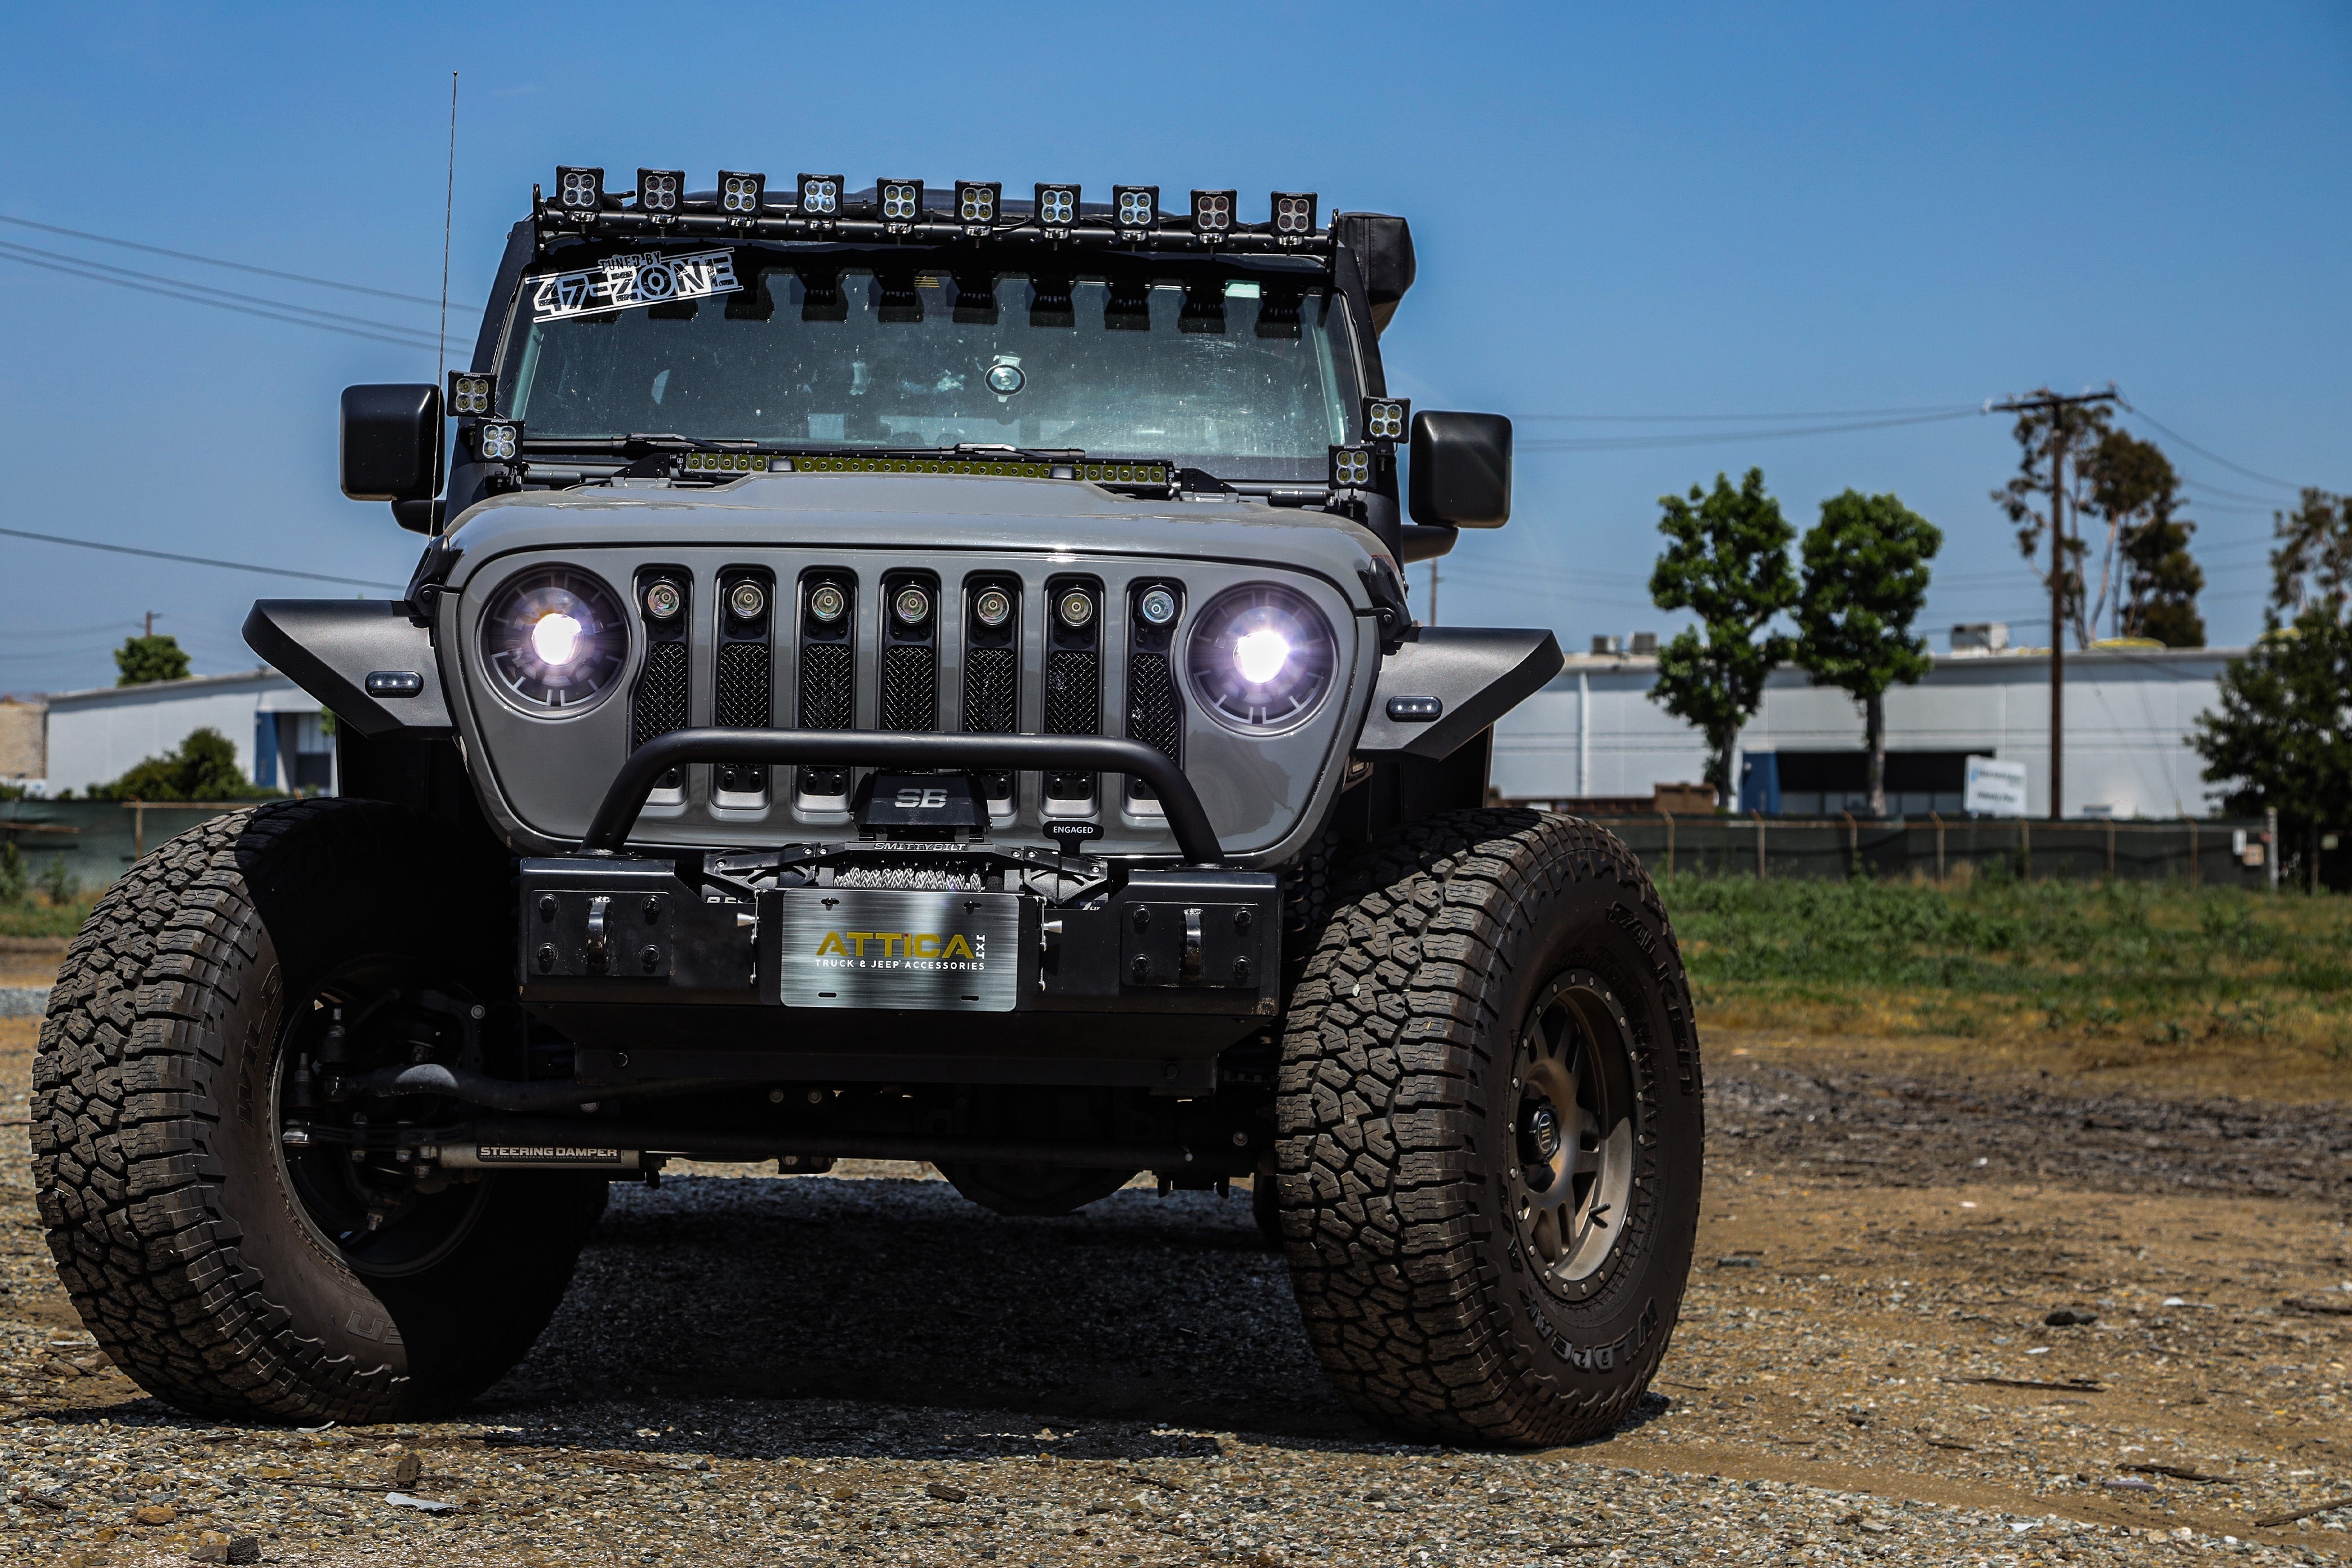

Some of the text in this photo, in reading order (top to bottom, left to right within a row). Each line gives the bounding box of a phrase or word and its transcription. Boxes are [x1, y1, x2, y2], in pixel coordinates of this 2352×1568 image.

[598, 251, 661, 271] TUNED BY
[535, 254, 737, 313] 47-ZONE
[895, 788, 948, 808] SB
[1053, 826, 1094, 834] ENGAGED
[873, 842, 966, 851] SMITTYBILT
[815, 959, 854, 968] TRUCK
[905, 961, 985, 970] ACCESSORIES
[480, 1146, 618, 1157] STEERING DAMPER
[1518, 1282, 1658, 1372] WILDPEAK
